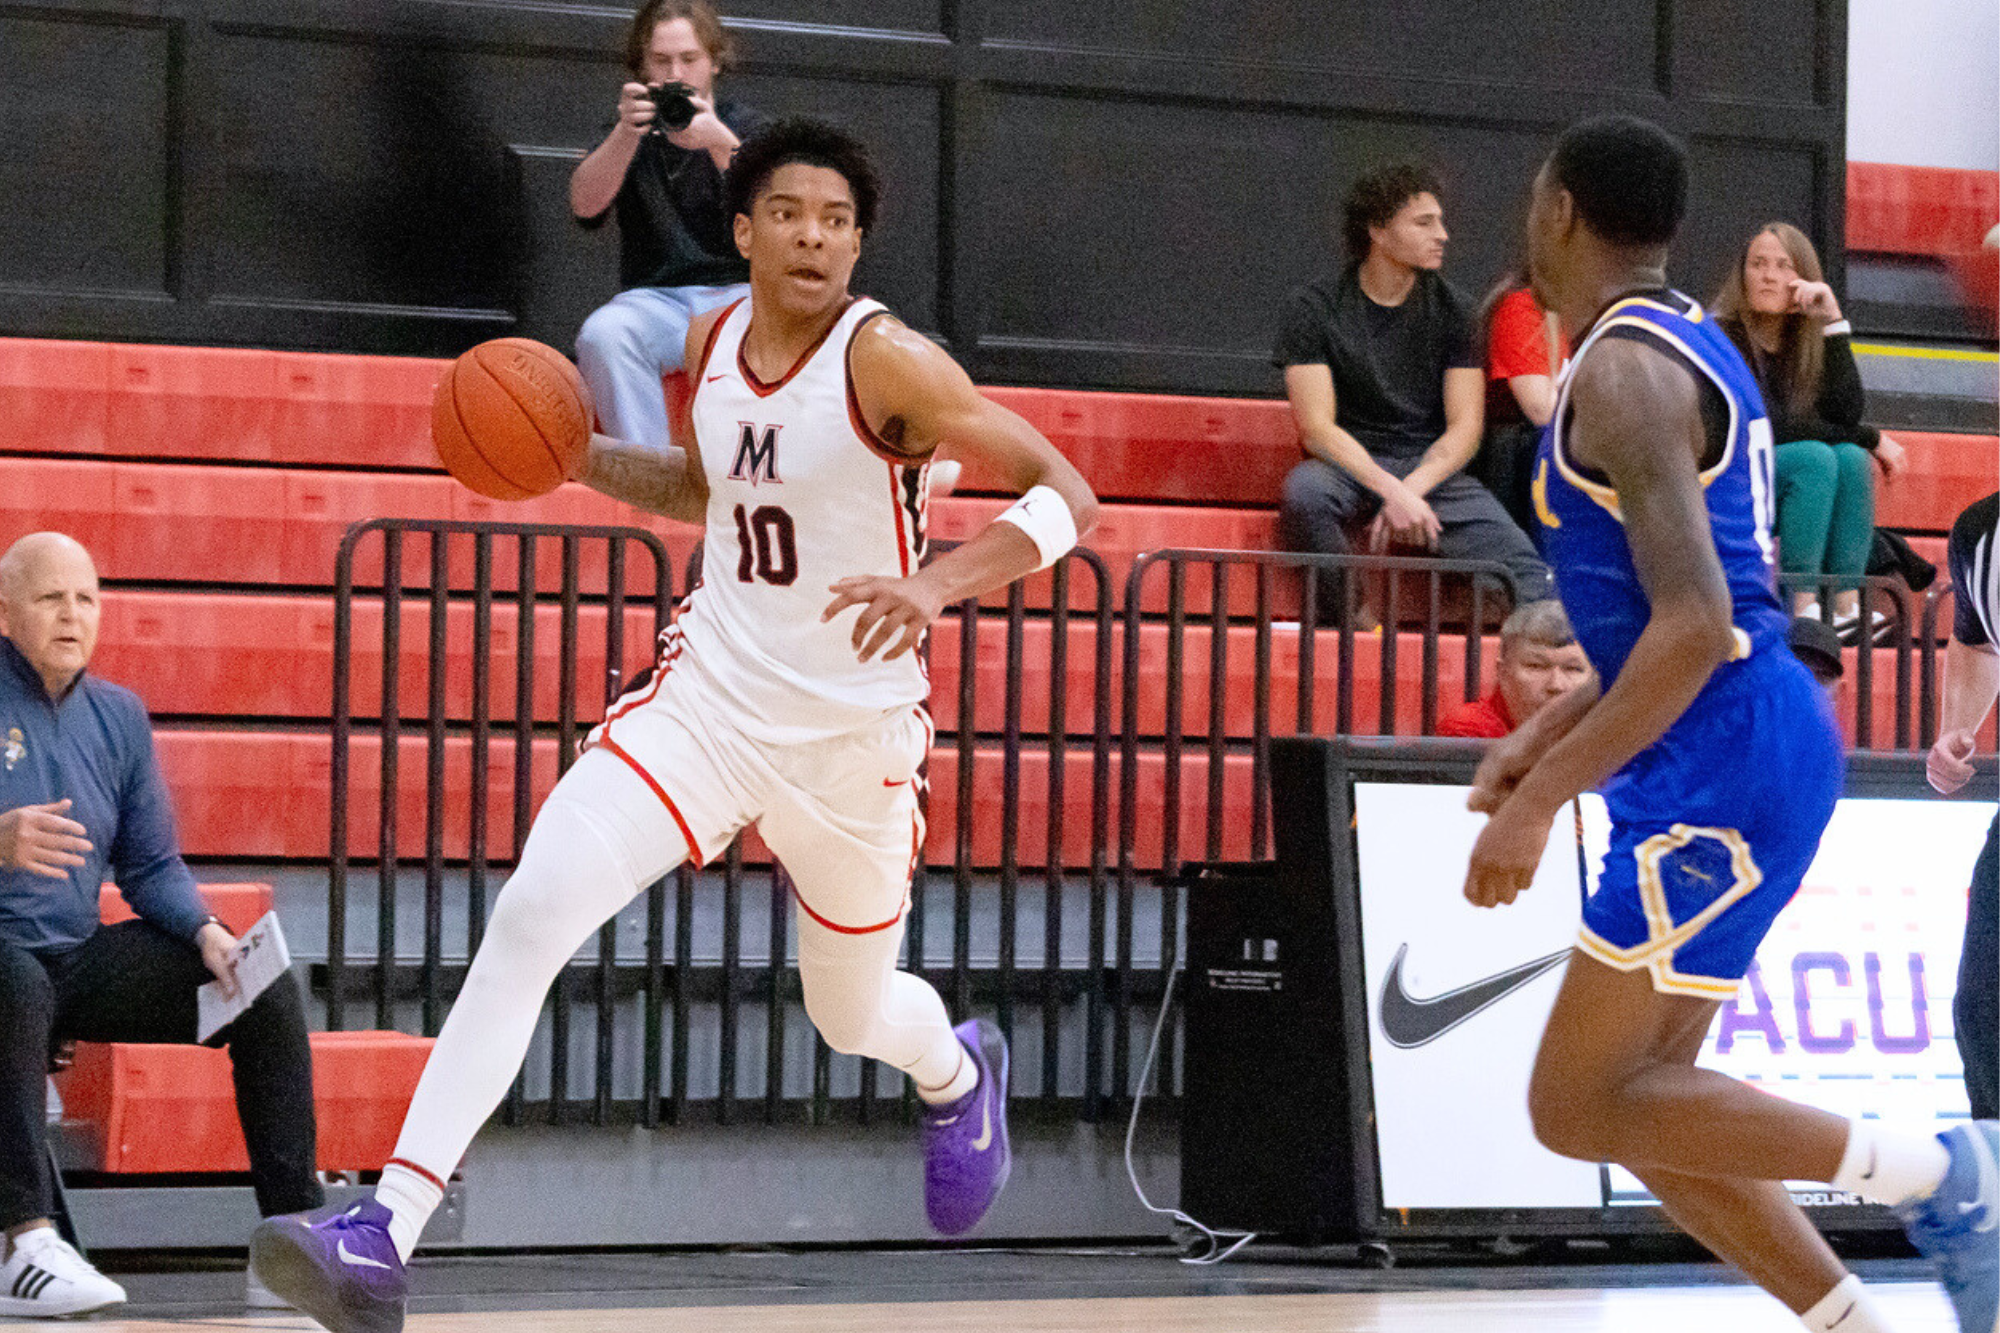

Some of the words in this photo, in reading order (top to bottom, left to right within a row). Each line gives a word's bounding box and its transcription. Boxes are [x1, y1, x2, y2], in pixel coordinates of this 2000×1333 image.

[511, 353, 582, 450] LDING
[727, 421, 784, 487] M
[733, 503, 798, 587] 10
